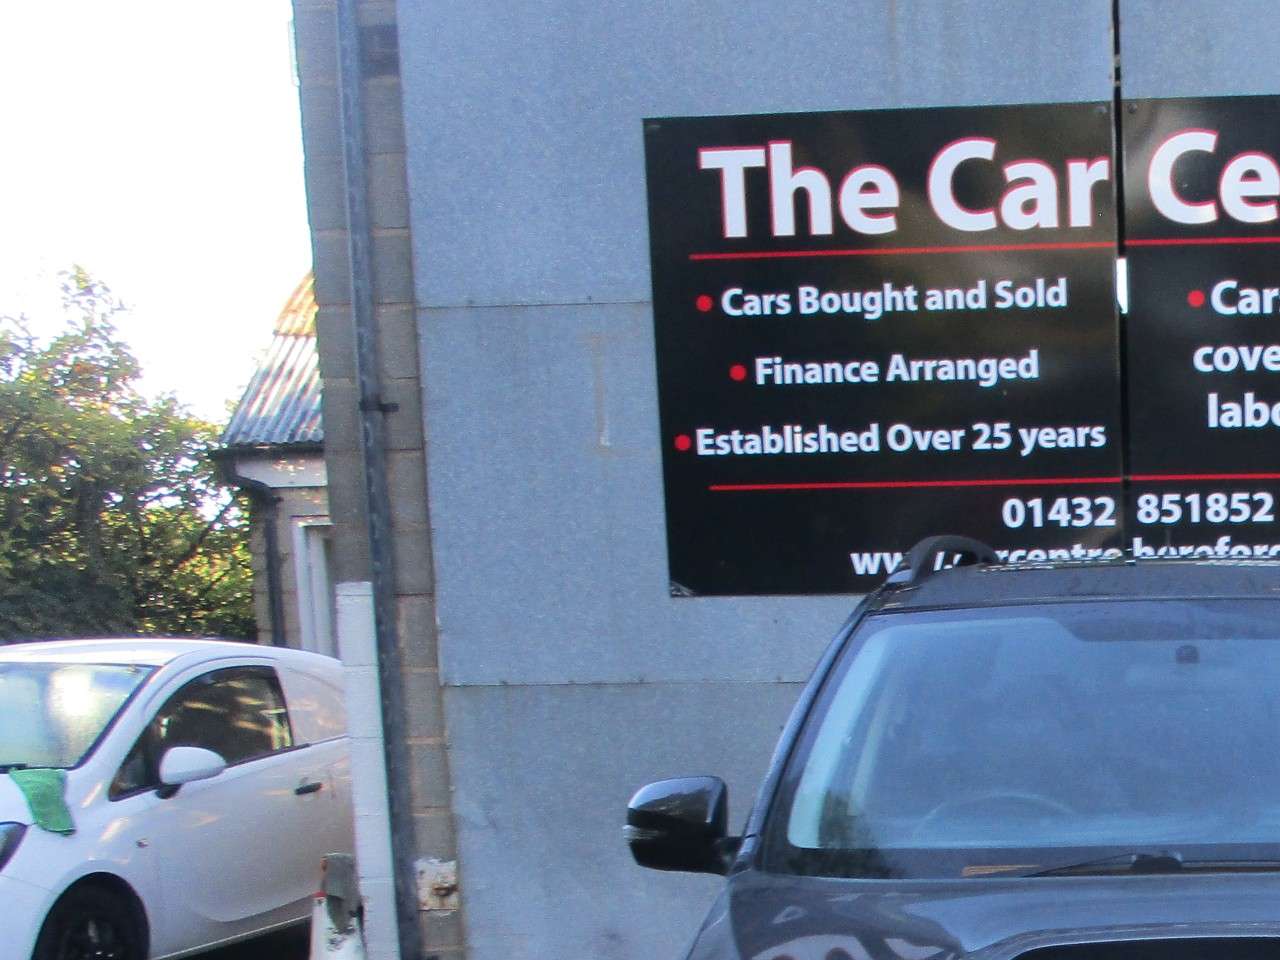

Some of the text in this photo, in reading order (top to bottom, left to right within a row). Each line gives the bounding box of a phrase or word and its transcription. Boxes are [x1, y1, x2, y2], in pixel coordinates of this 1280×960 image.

[698, 139, 900, 239] The
[927, 136, 1109, 233] Car
[721, 277, 1067, 320] Cars Bought and Sold
[755, 349, 1039, 388] Finance Arranged
[696, 423, 1107, 457] Established Over 25 years
[1002, 491, 1275, 529] 01432 851852
